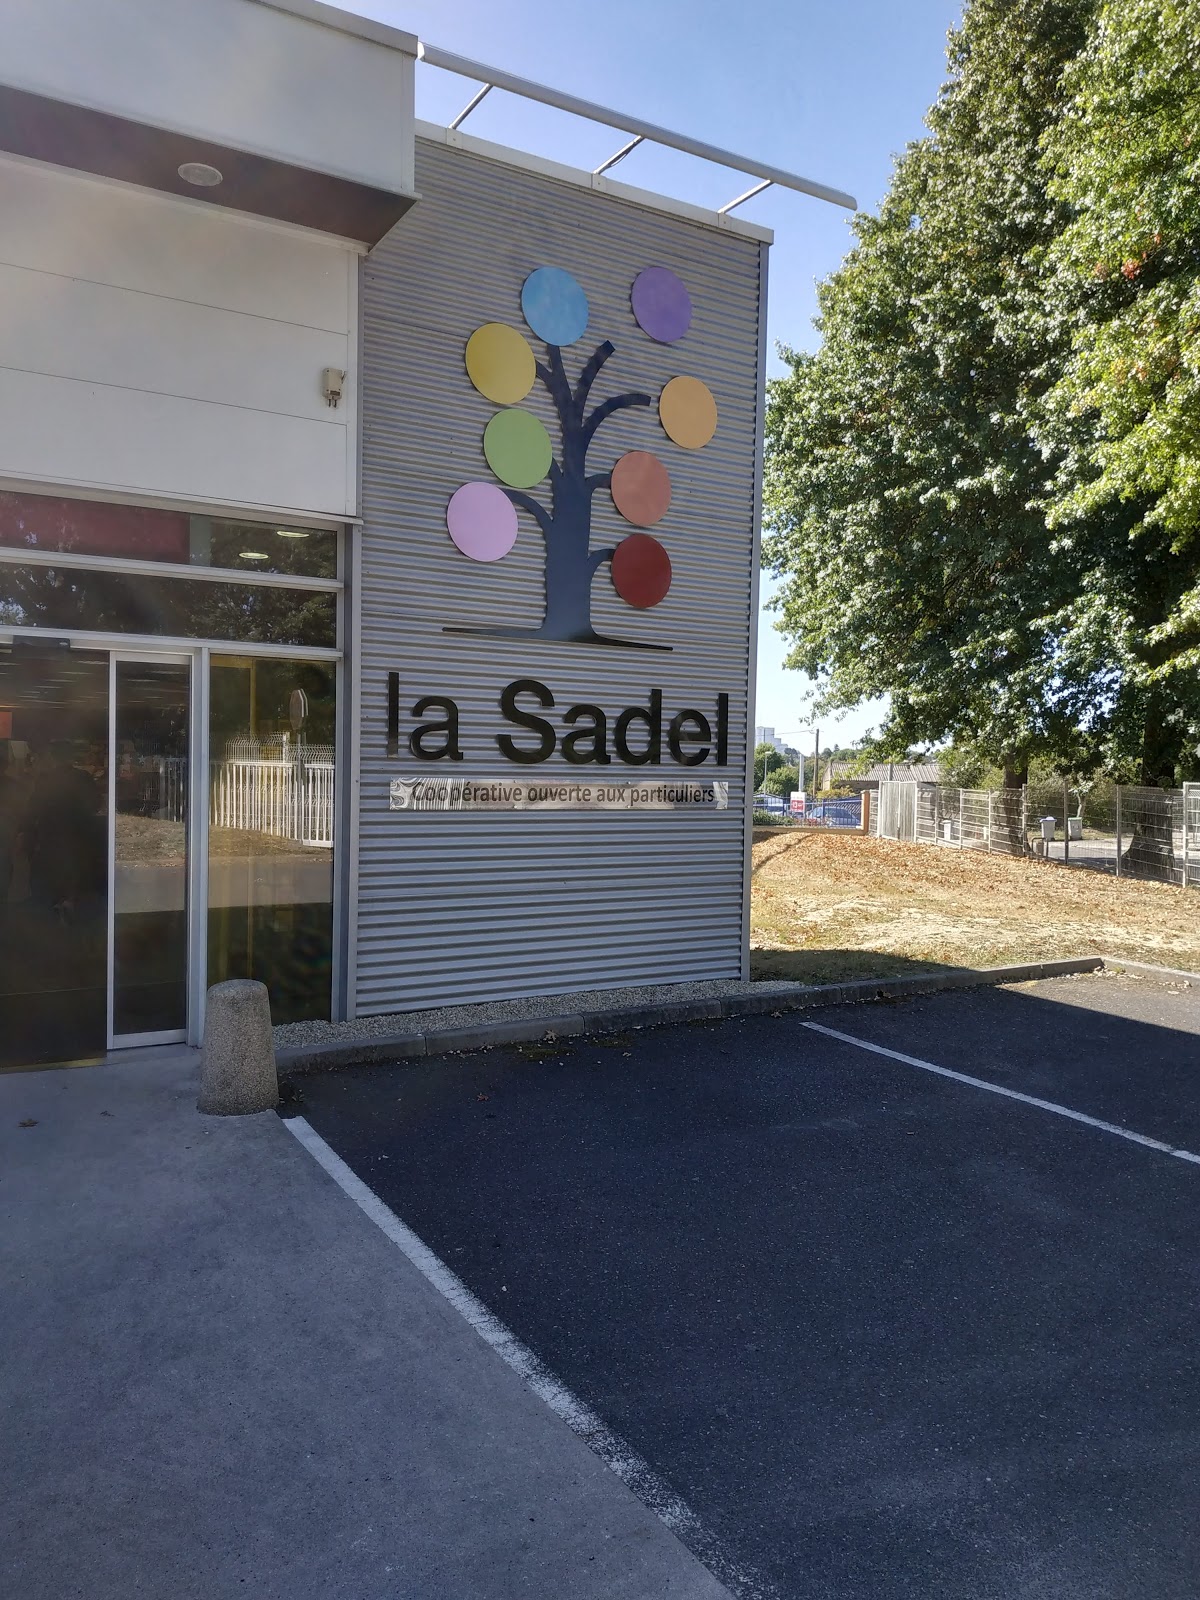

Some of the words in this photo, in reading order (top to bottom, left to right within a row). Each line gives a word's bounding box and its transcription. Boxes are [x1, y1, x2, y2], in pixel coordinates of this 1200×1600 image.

[388, 671, 464, 761] la
[496, 679, 729, 767] Sadel
[411, 780, 522, 806] Coopérative
[527, 785, 591, 803] ouverte
[597, 787, 625, 804] aux
[630, 785, 715, 806] particuliers
